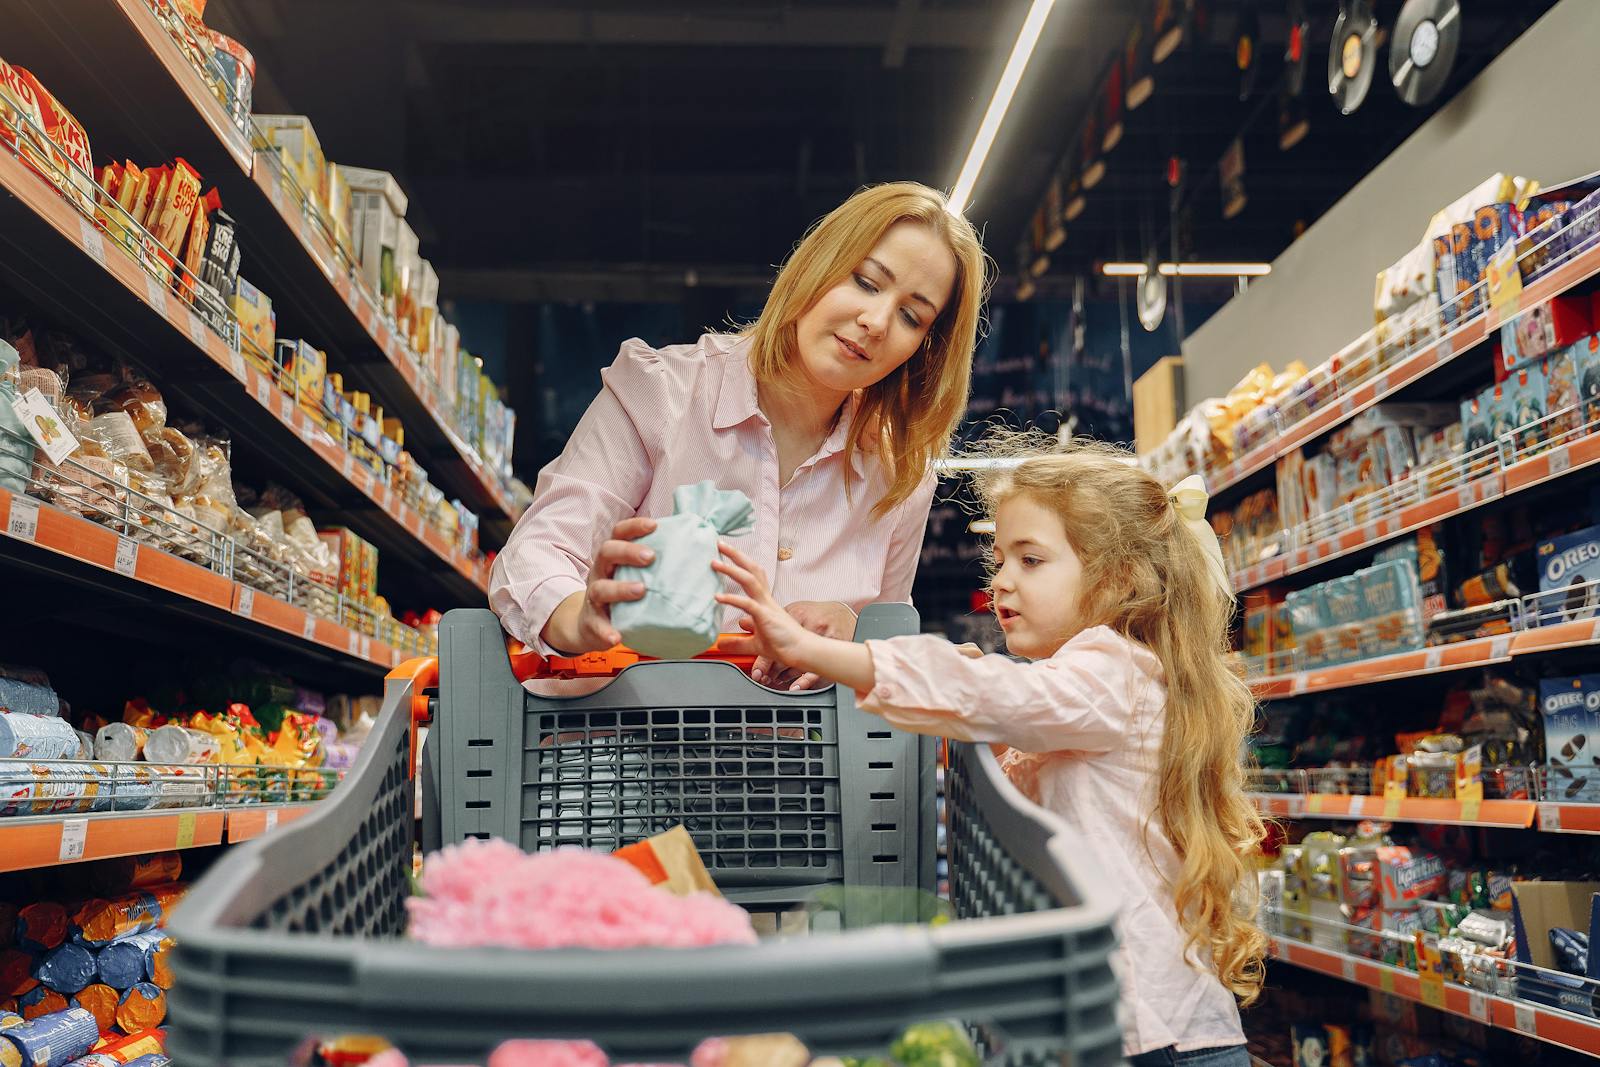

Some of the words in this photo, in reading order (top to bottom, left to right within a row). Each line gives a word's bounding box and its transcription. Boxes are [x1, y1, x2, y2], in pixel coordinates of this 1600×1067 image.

[173, 194, 192, 217] SKO
[211, 241, 230, 262] SKO
[1547, 543, 1599, 581] OREO
